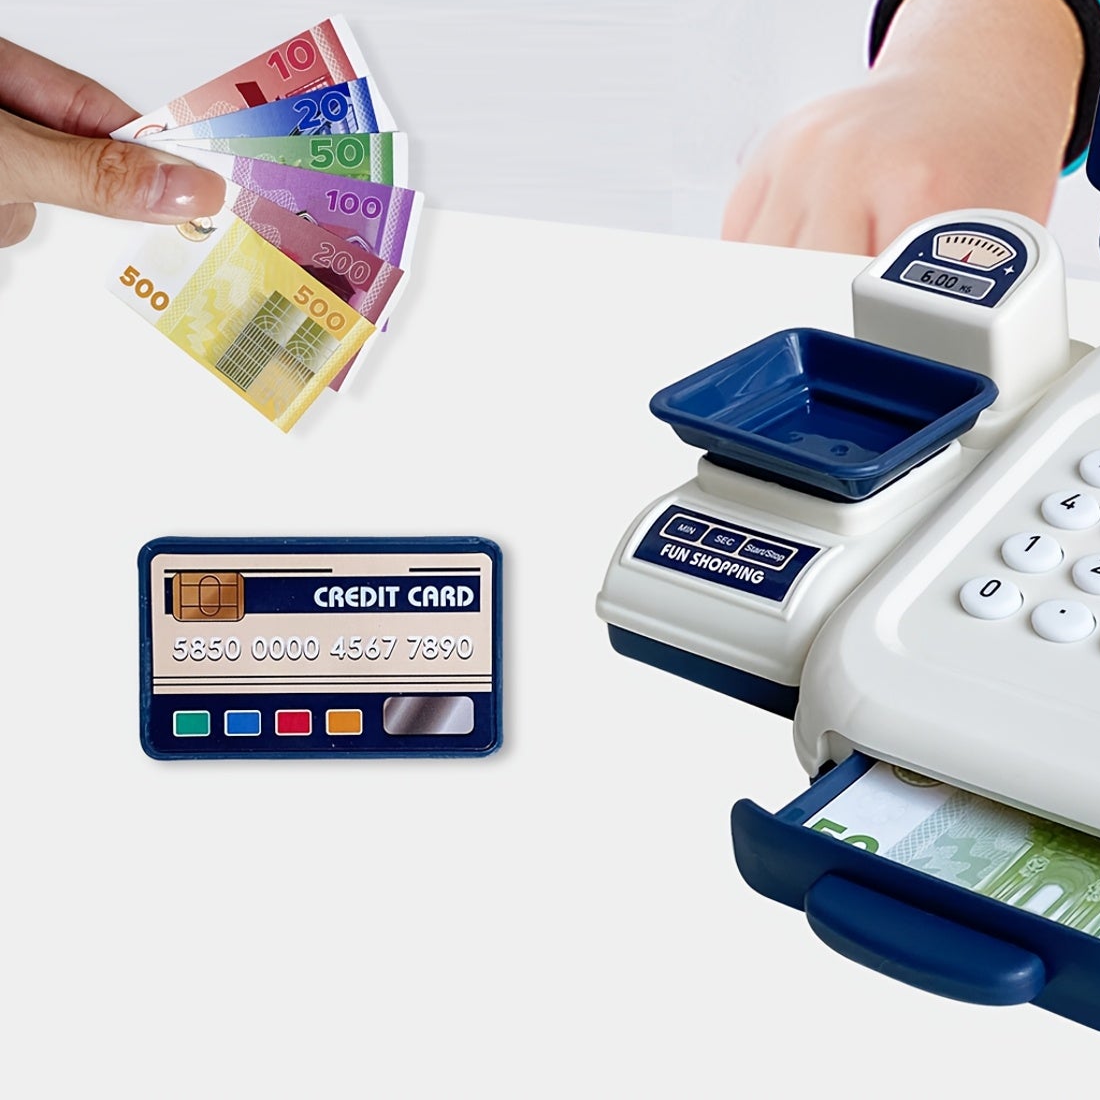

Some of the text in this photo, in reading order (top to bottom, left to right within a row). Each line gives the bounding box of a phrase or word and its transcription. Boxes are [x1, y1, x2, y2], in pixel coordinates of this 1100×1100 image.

[267, 38, 316, 81] 10
[293, 90, 349, 132] 20
[309, 136, 365, 169] 50
[325, 188, 383, 220] 100
[312, 241, 372, 285] 200
[118, 264, 170, 312] 500
[293, 284, 347, 333] 500
[1060, 493, 1081, 510] 4
[677, 523, 697, 535] MIN
[714, 534, 735, 547] SEC
[1024, 535, 1041, 552] 1
[660, 543, 765, 584] FUN SHOPPING
[313, 585, 475, 608] CREDIT CARD
[979, 579, 1001, 598] 0
[172, 635, 474, 662] 5850 0000 4567 7890
